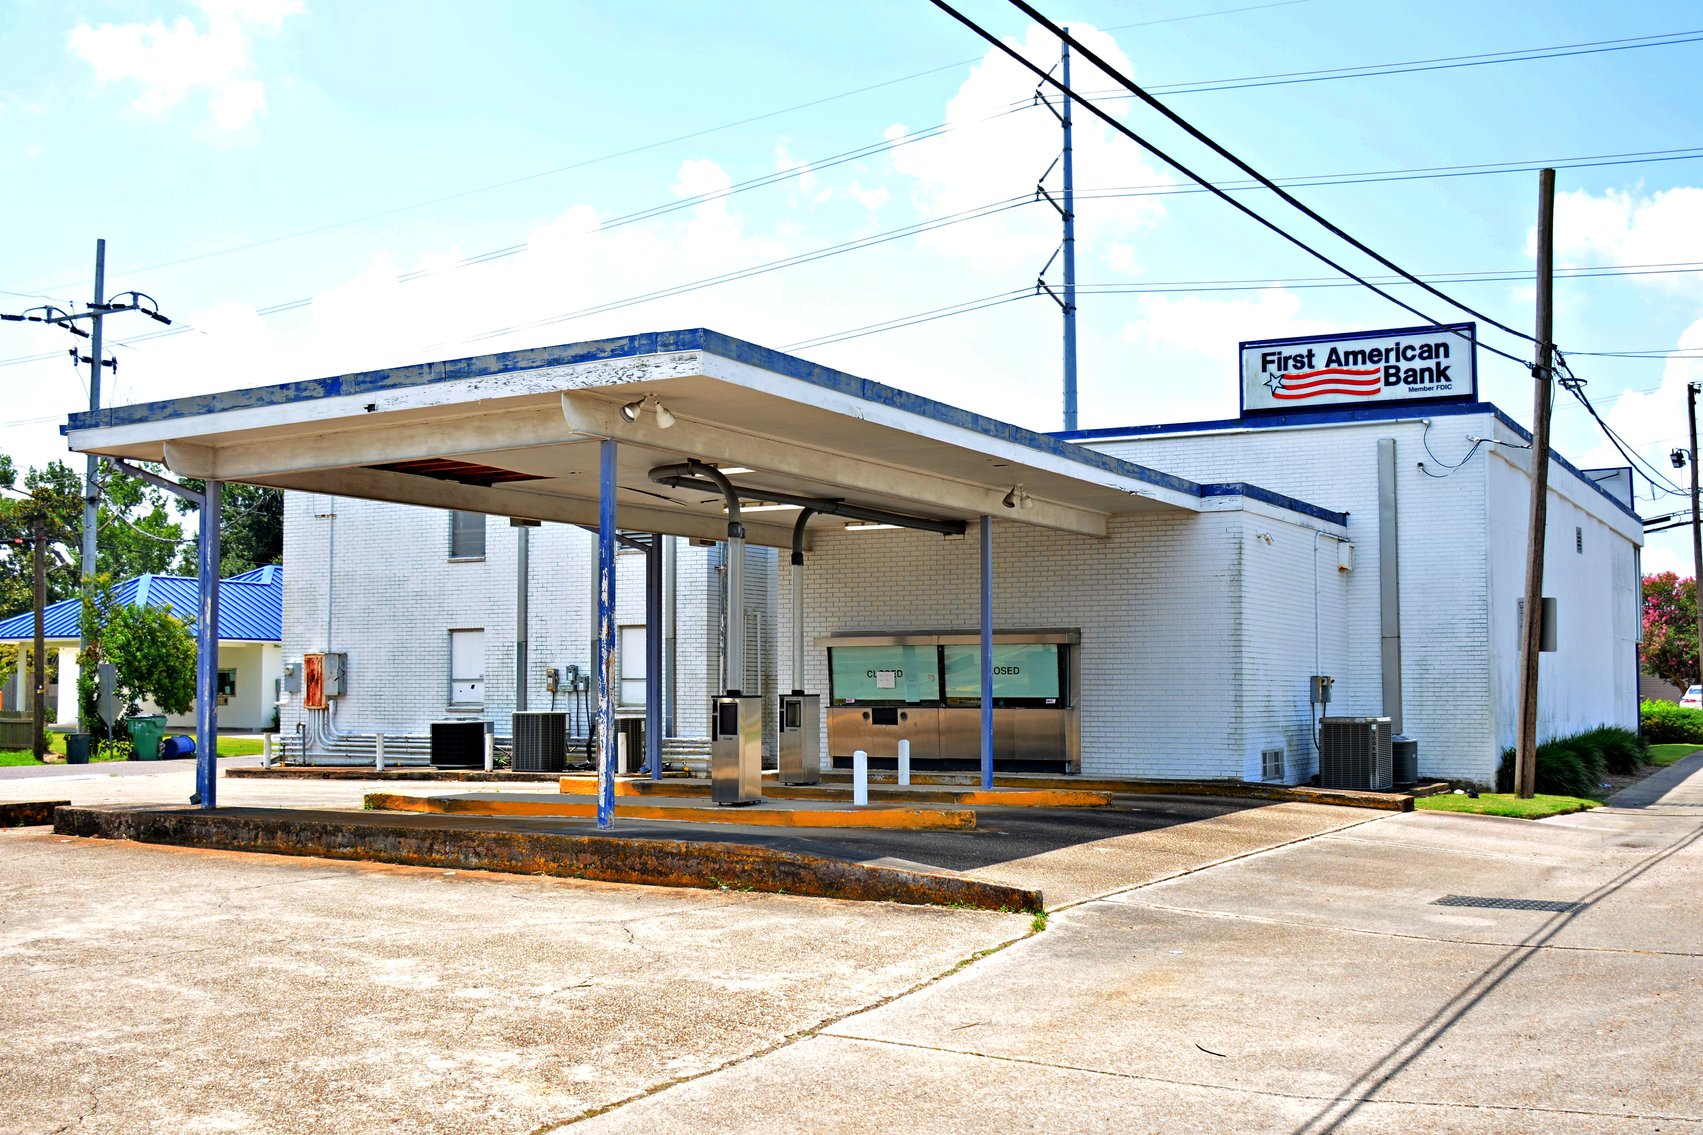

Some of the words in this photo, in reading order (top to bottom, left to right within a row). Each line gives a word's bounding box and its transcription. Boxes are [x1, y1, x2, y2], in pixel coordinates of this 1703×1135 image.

[1261, 349, 1315, 372] First
[1325, 342, 1450, 368] American
[1383, 361, 1452, 387] Bank
[867, 669, 903, 678] CLD
[992, 666, 1020, 675] OSED
